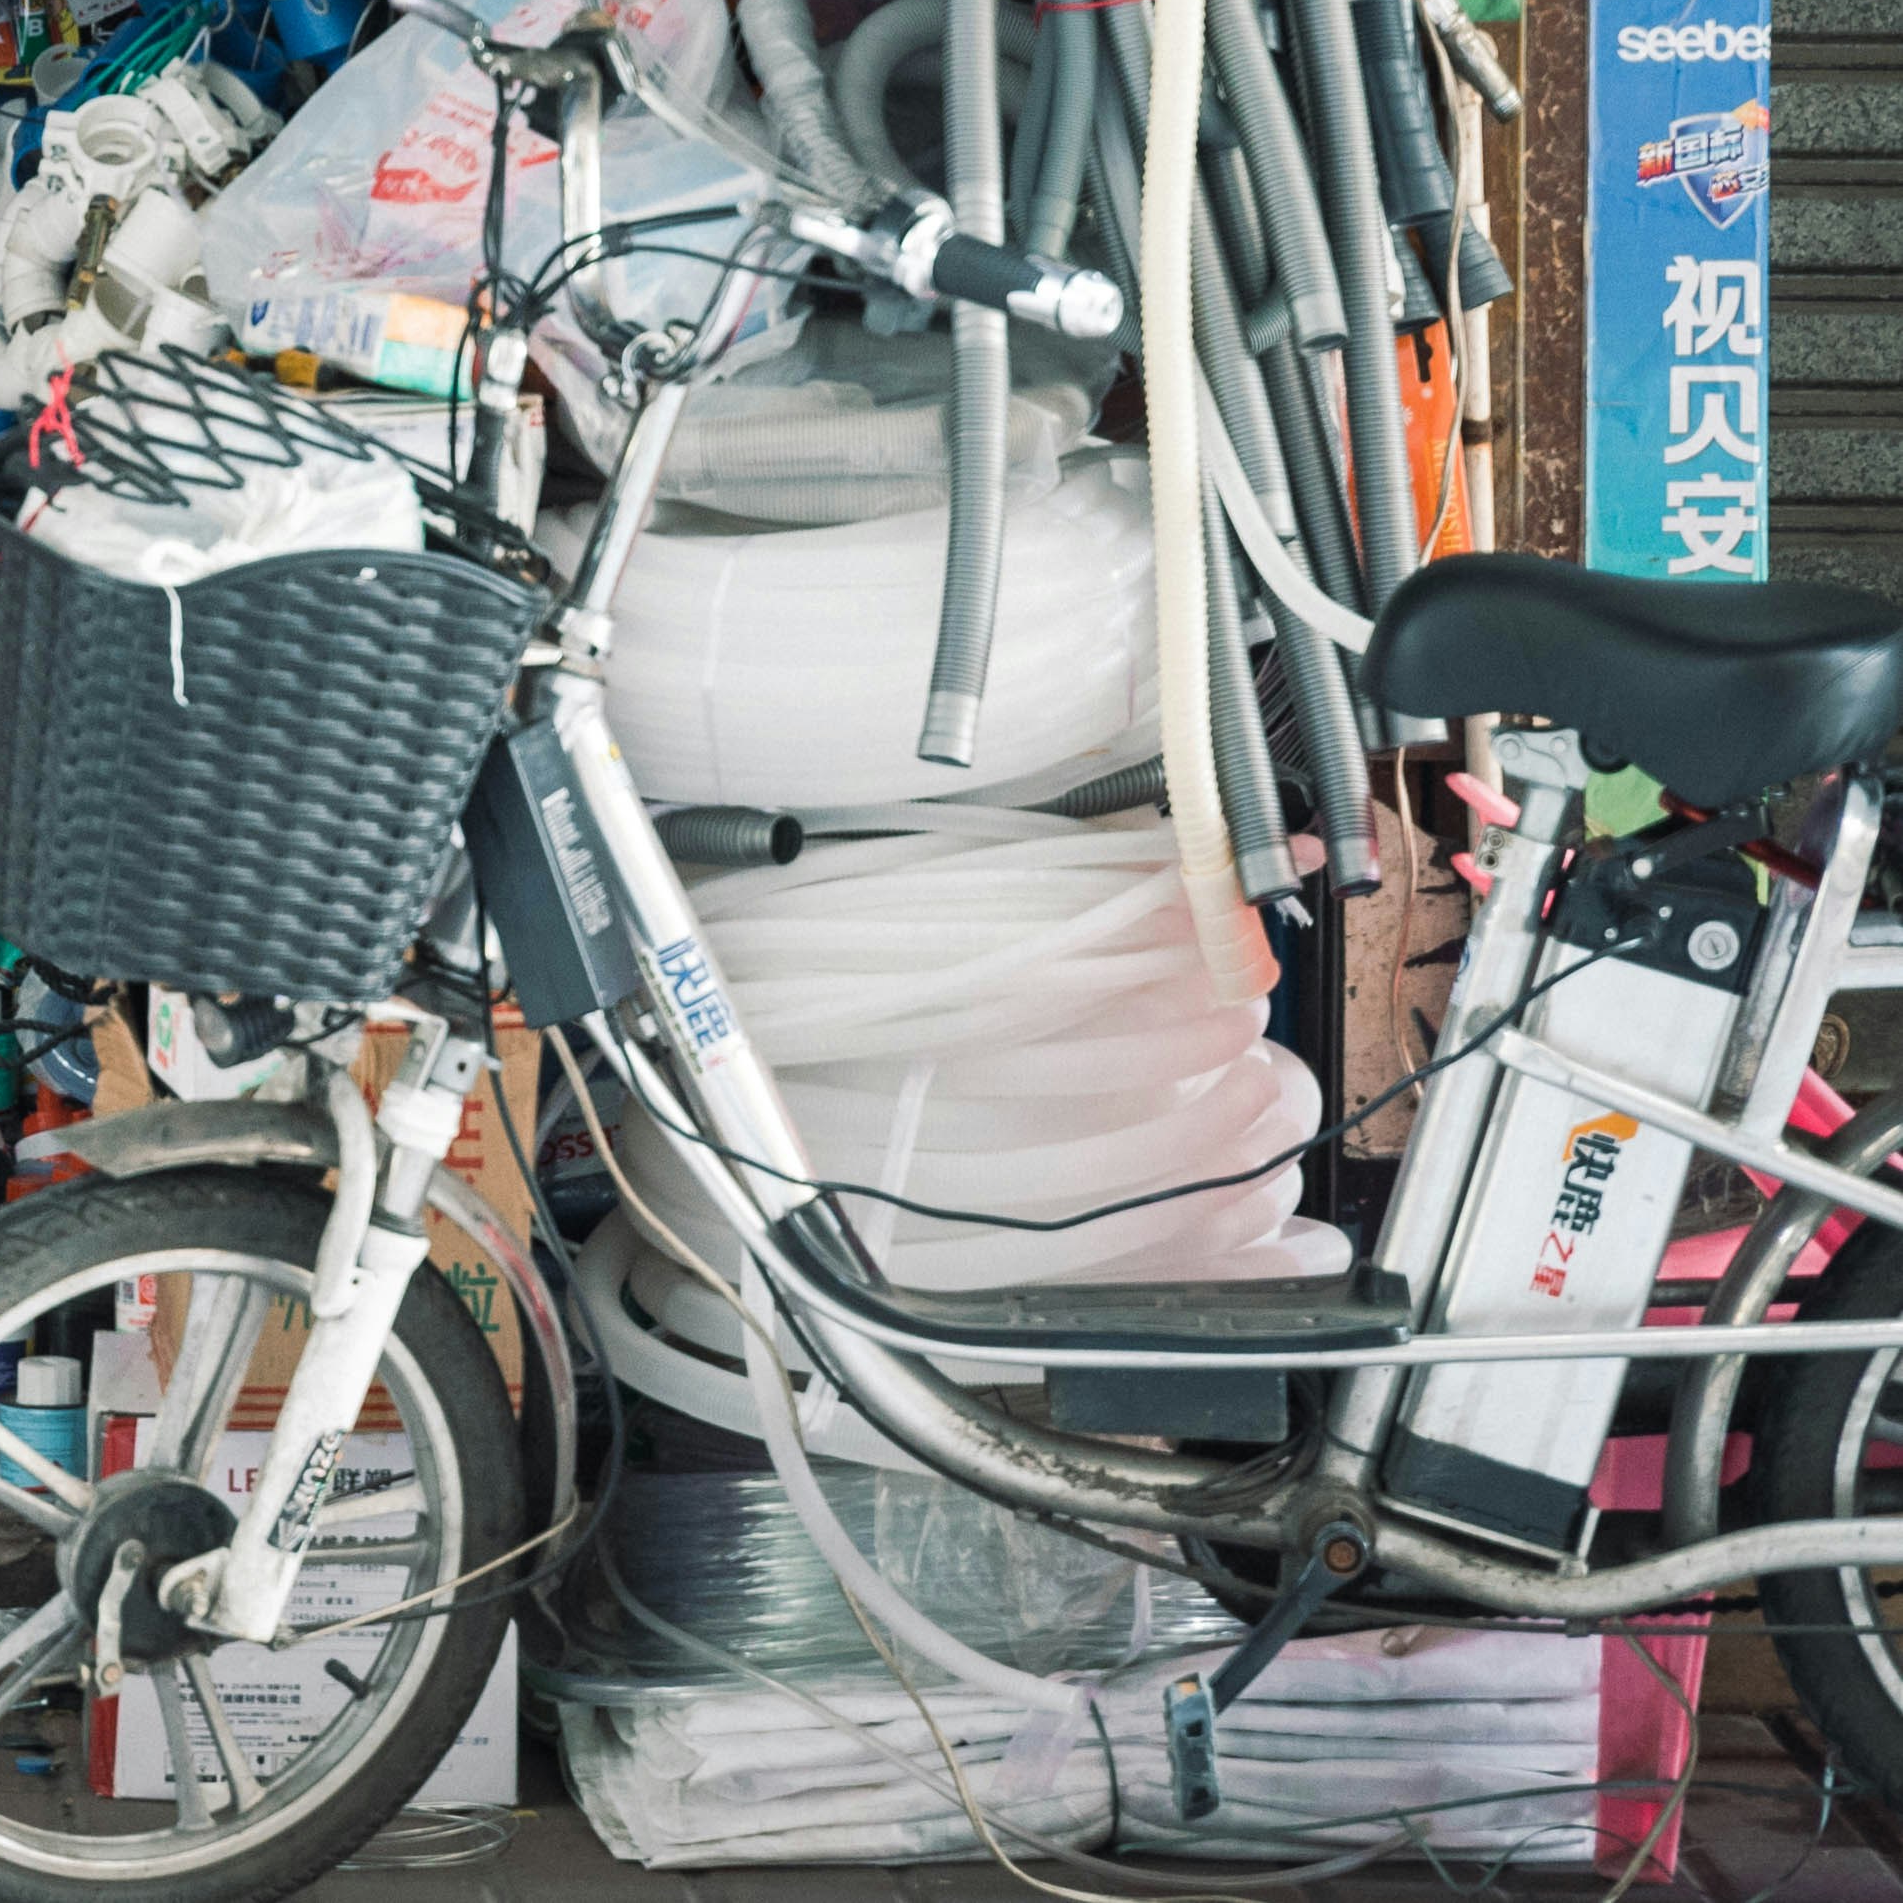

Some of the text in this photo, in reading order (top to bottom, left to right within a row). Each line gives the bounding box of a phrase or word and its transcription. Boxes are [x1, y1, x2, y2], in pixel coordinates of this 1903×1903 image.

[27, 18, 45, 37] B
[1661, 254, 1763, 576] 视贝安
